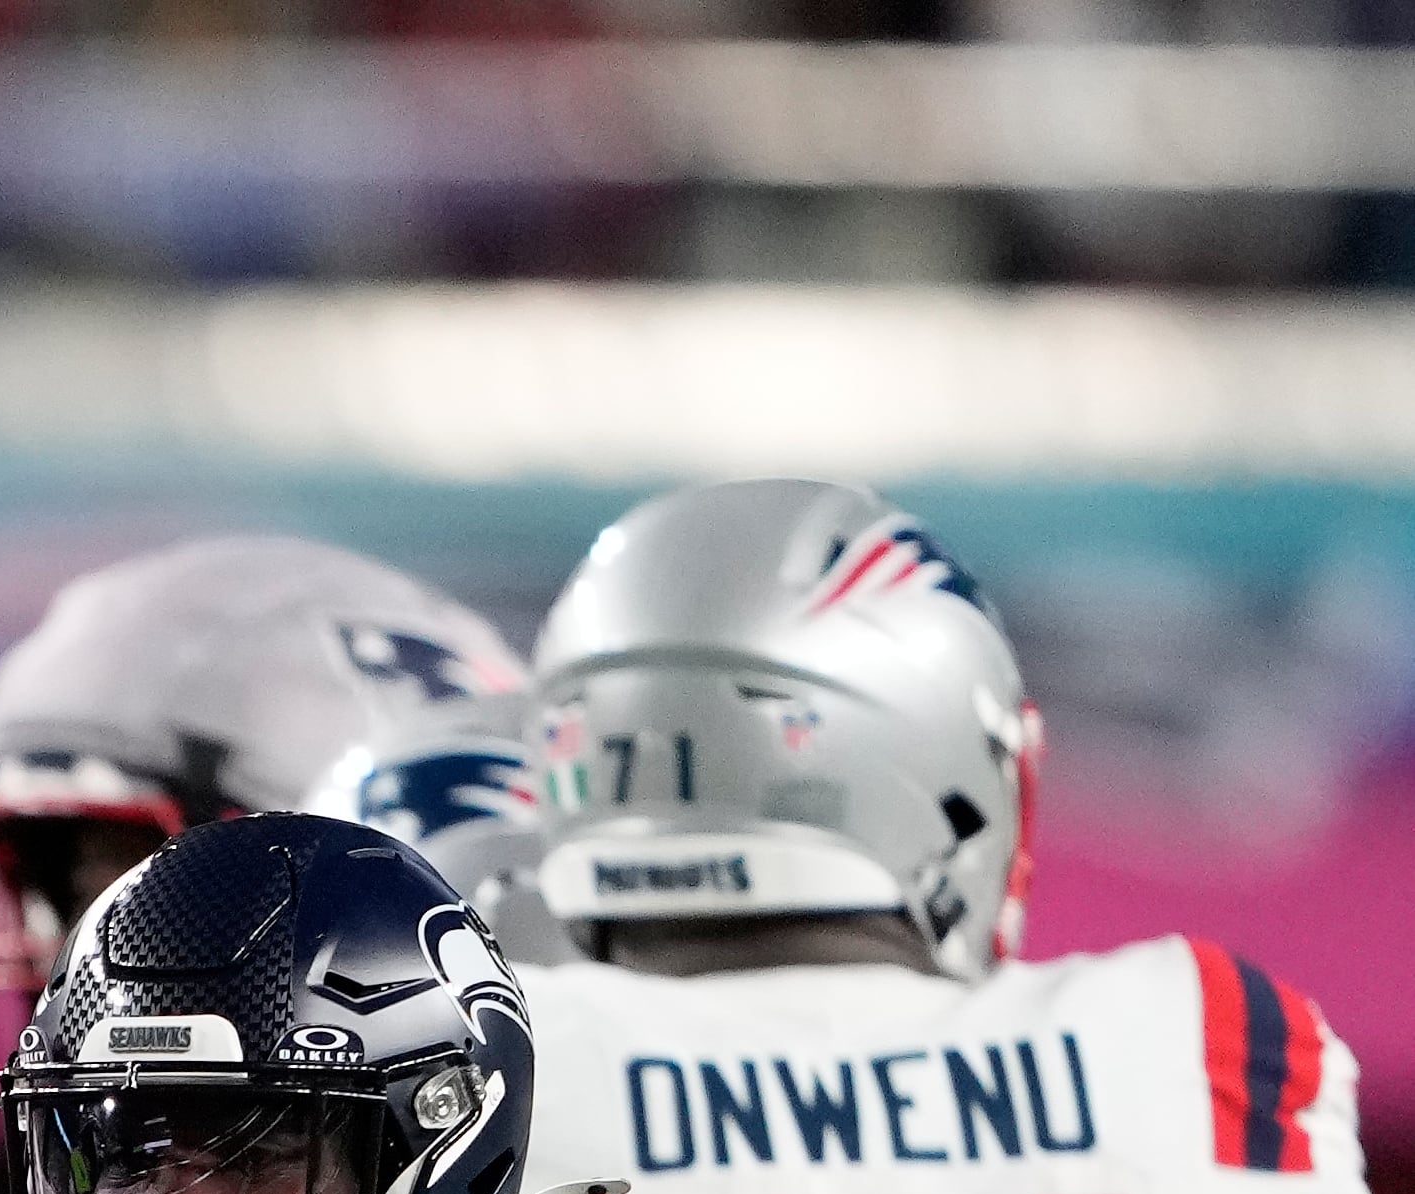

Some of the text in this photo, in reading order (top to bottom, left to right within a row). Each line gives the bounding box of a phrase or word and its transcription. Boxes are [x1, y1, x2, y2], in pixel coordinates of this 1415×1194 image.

[601, 731, 695, 804] 71
[108, 1026, 192, 1050] SEAHAWKS
[278, 1051, 361, 1063] OAKLEY
[626, 1029, 1098, 1174] ONWENU
